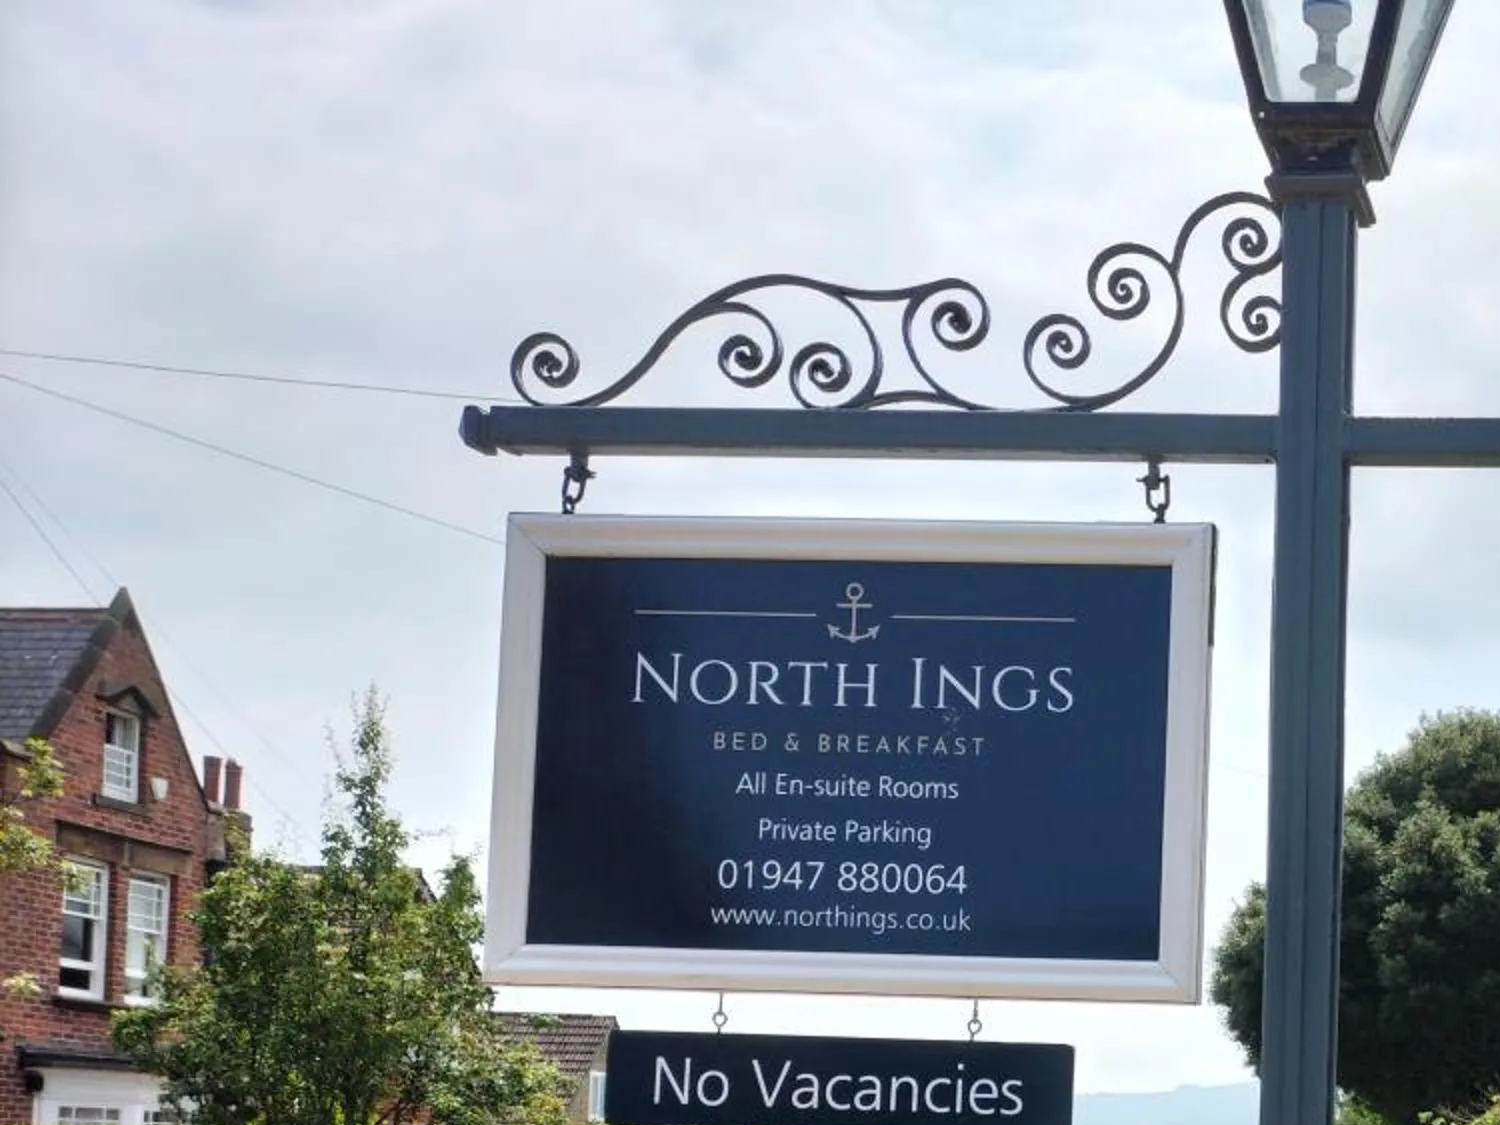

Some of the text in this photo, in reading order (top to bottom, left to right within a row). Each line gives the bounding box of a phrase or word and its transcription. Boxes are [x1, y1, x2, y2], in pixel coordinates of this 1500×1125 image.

[633, 652, 1074, 713] NORTH INGS
[713, 731, 985, 756] BED & BREAKFAST
[735, 771, 959, 800] All En-suite Rooms
[758, 817, 932, 851] Private Parking
[718, 859, 968, 895] 01947 880064
[711, 904, 971, 935] www.northings.co.uk
[653, 1055, 1023, 1116] No Vacancies
